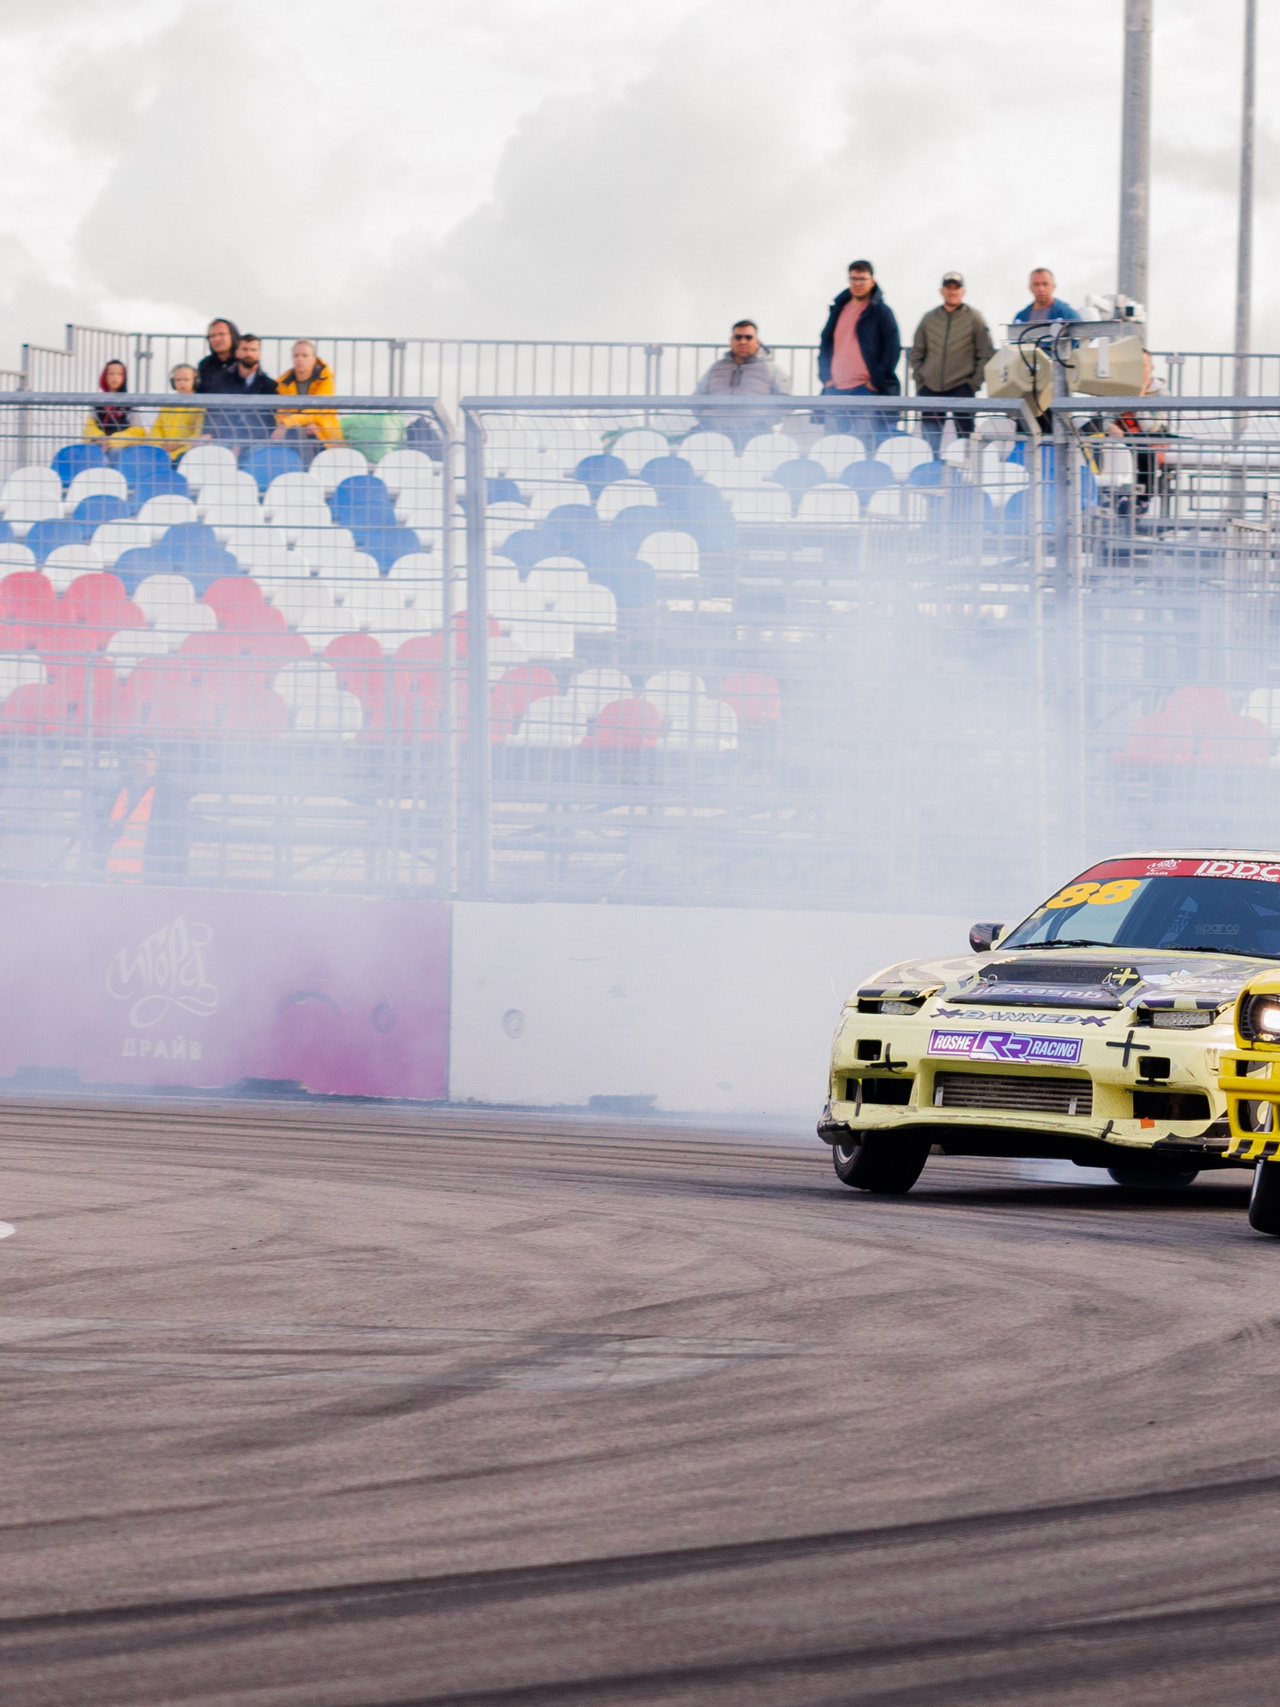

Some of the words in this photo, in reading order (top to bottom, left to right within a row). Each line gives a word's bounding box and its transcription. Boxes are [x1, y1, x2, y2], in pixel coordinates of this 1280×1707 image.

[1045, 879, 1142, 909] 88
[960, 1009, 1083, 1024] BANNED
[122, 1035, 202, 1060] ДРАЙВ
[933, 1033, 974, 1050] ROSHE
[1030, 1041, 1077, 1057] RACING
